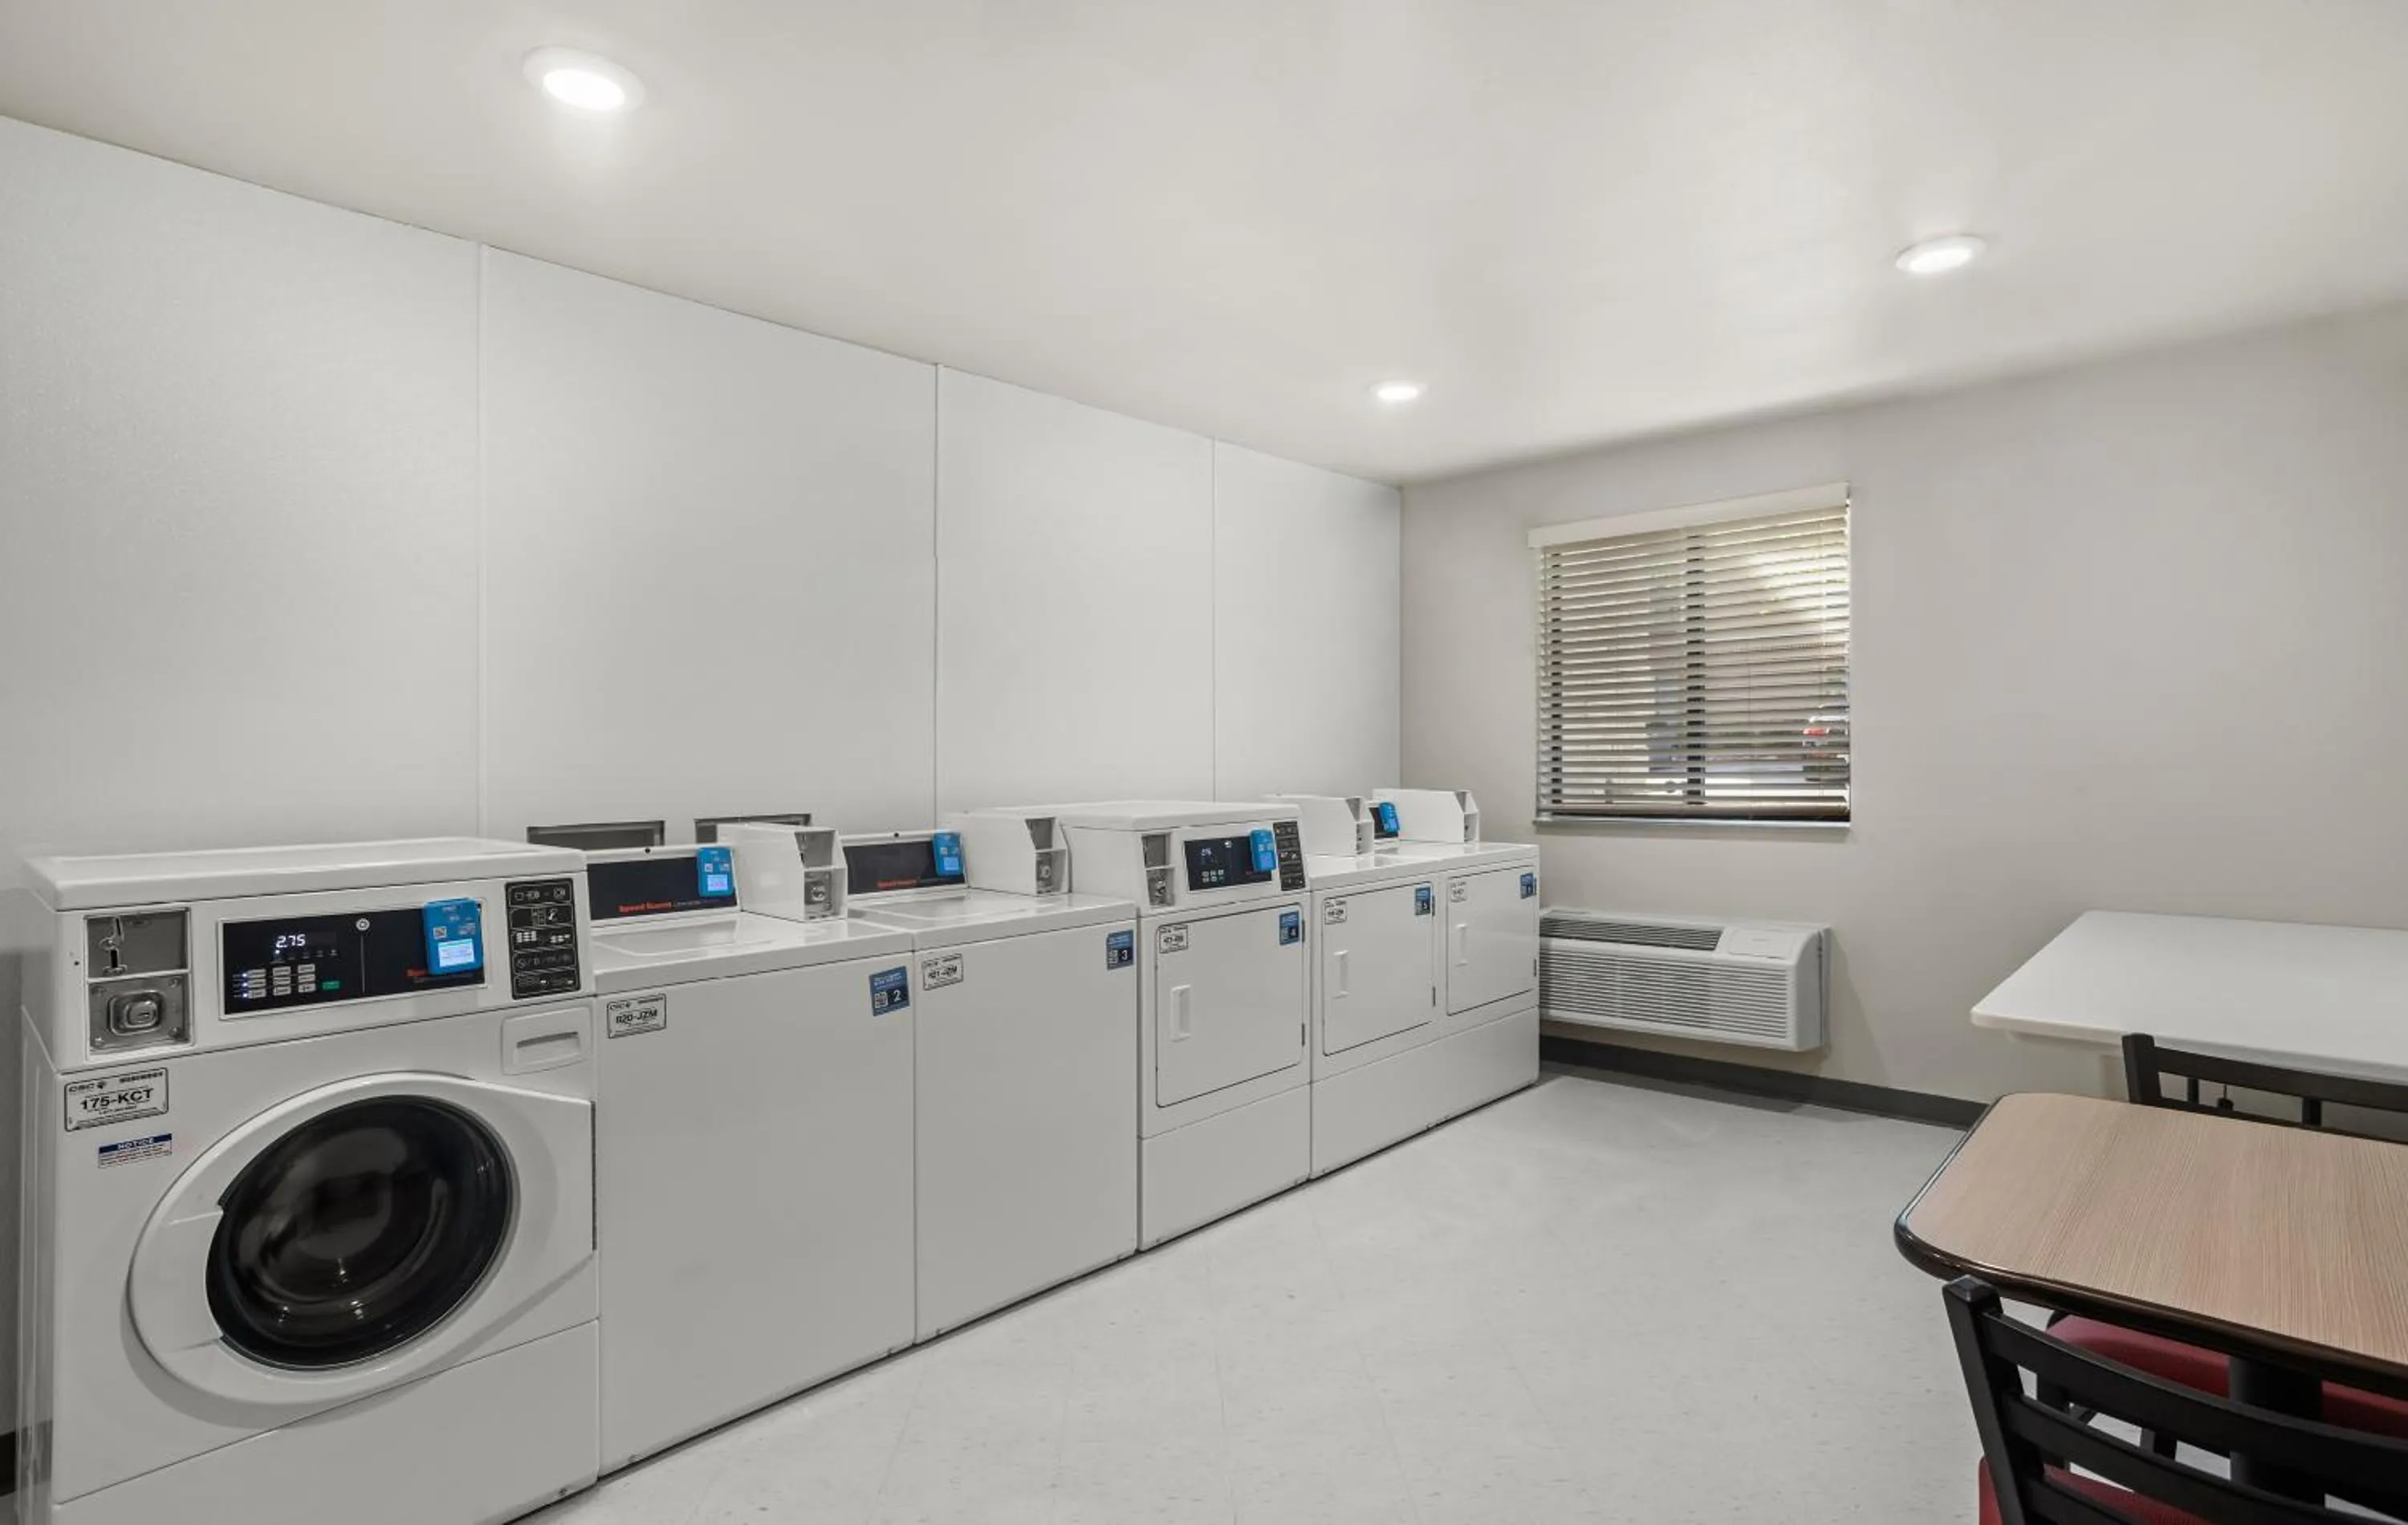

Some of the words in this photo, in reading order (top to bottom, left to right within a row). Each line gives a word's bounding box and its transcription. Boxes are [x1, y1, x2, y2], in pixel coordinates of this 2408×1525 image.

[1121, 949, 1129, 962] 3
[893, 989, 902, 1003] 2
[80, 1088, 155, 1110] 175-KCT
